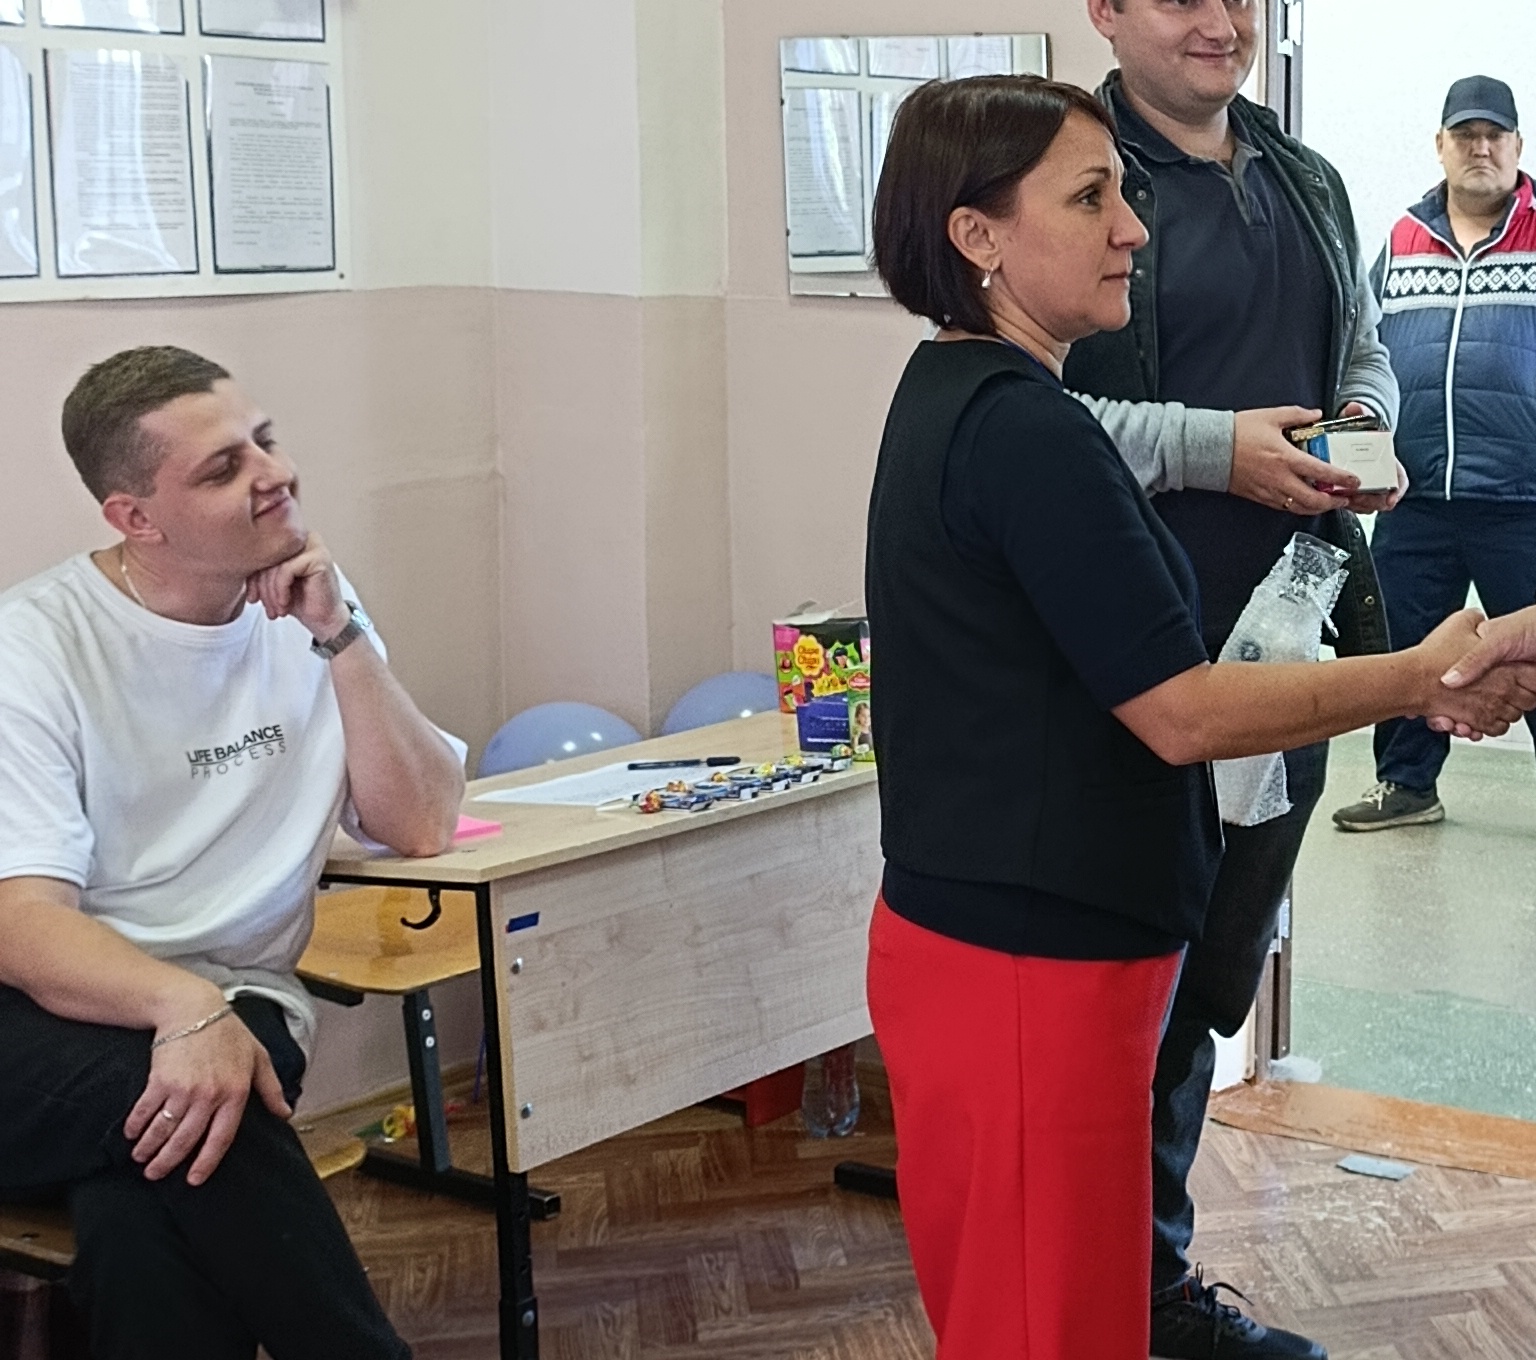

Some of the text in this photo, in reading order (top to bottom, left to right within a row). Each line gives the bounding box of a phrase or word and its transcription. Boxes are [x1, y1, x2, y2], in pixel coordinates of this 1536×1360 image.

[186, 724, 284, 763] LIFE BALANCE
[190, 740, 287, 780] PROCESS
